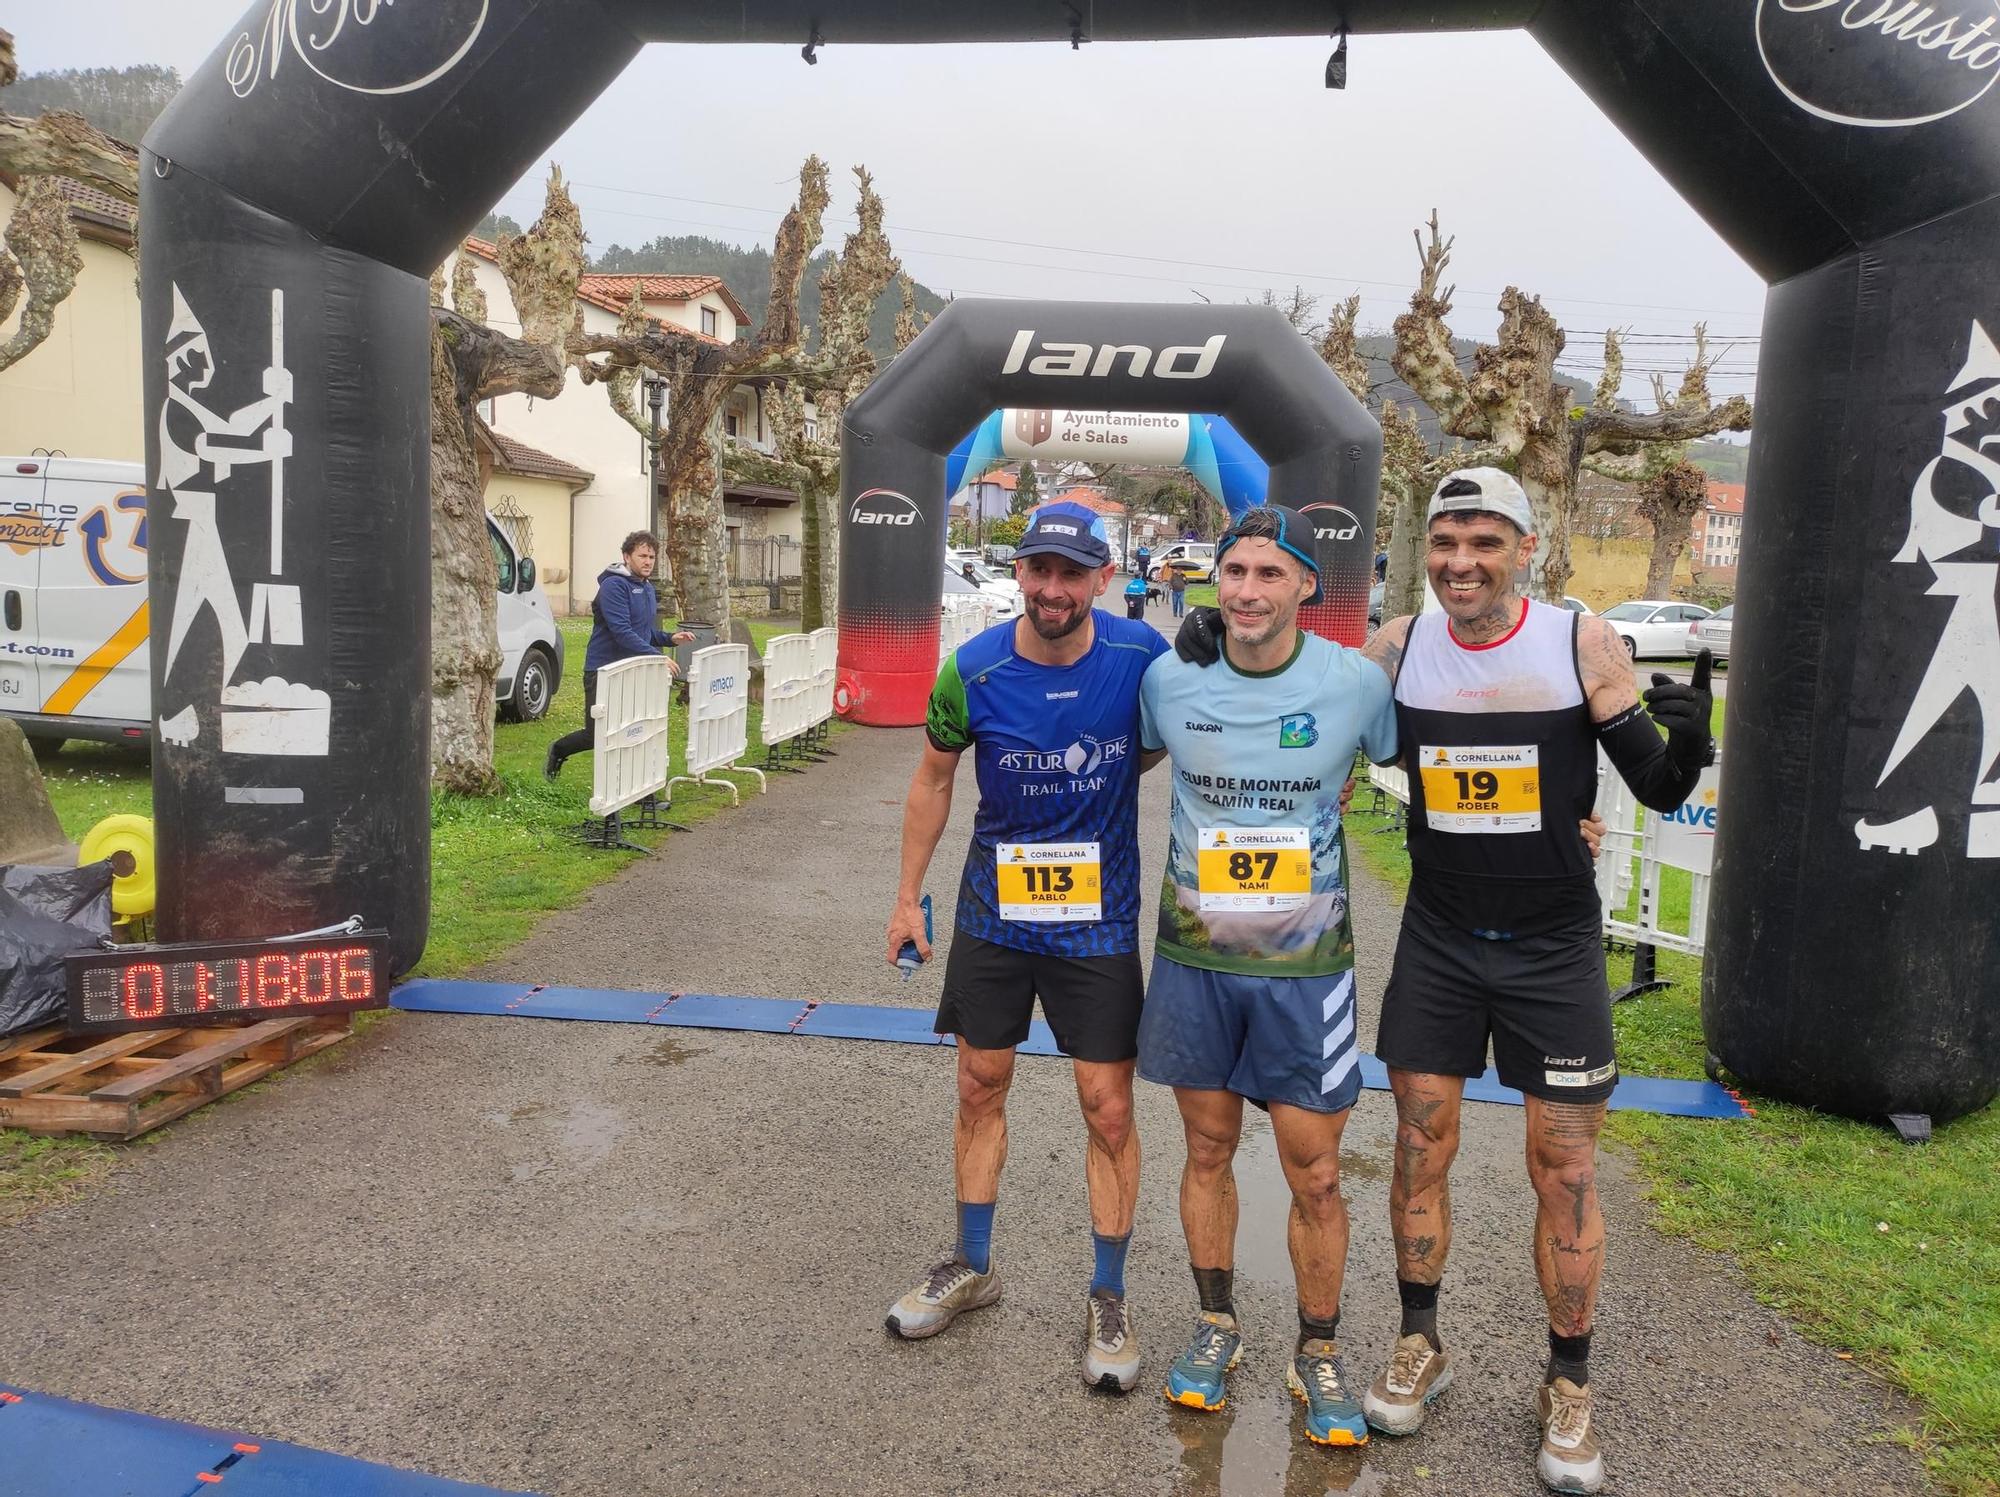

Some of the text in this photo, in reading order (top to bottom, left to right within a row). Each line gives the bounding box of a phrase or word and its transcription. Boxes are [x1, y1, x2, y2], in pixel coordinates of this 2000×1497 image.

[1001, 329, 1228, 379] land
[1063, 410, 1179, 429] Ayuntamiento
[1062, 429, 1128, 445] de Salas
[851, 508, 917, 526] land
[1184, 721, 1223, 734] SUKAN
[1455, 754, 1522, 763] CORNELLANA
[1020, 776, 1108, 796] TRAIL TEAM
[1180, 769, 1321, 793] CLUB DE MONTAÑA
[1453, 771, 1499, 801] 19
[1258, 797, 1295, 812] REAL
[1456, 801, 1500, 811] ROBER
[1233, 835, 1296, 844] CORNELLANA
[1030, 850, 1087, 859] CORNELLANA
[1228, 851, 1279, 881] 87
[1022, 866, 1074, 893] 113
[1238, 881, 1269, 890] NAMI
[1031, 893, 1067, 902] PABLO
[1543, 1055, 1587, 1066] land
